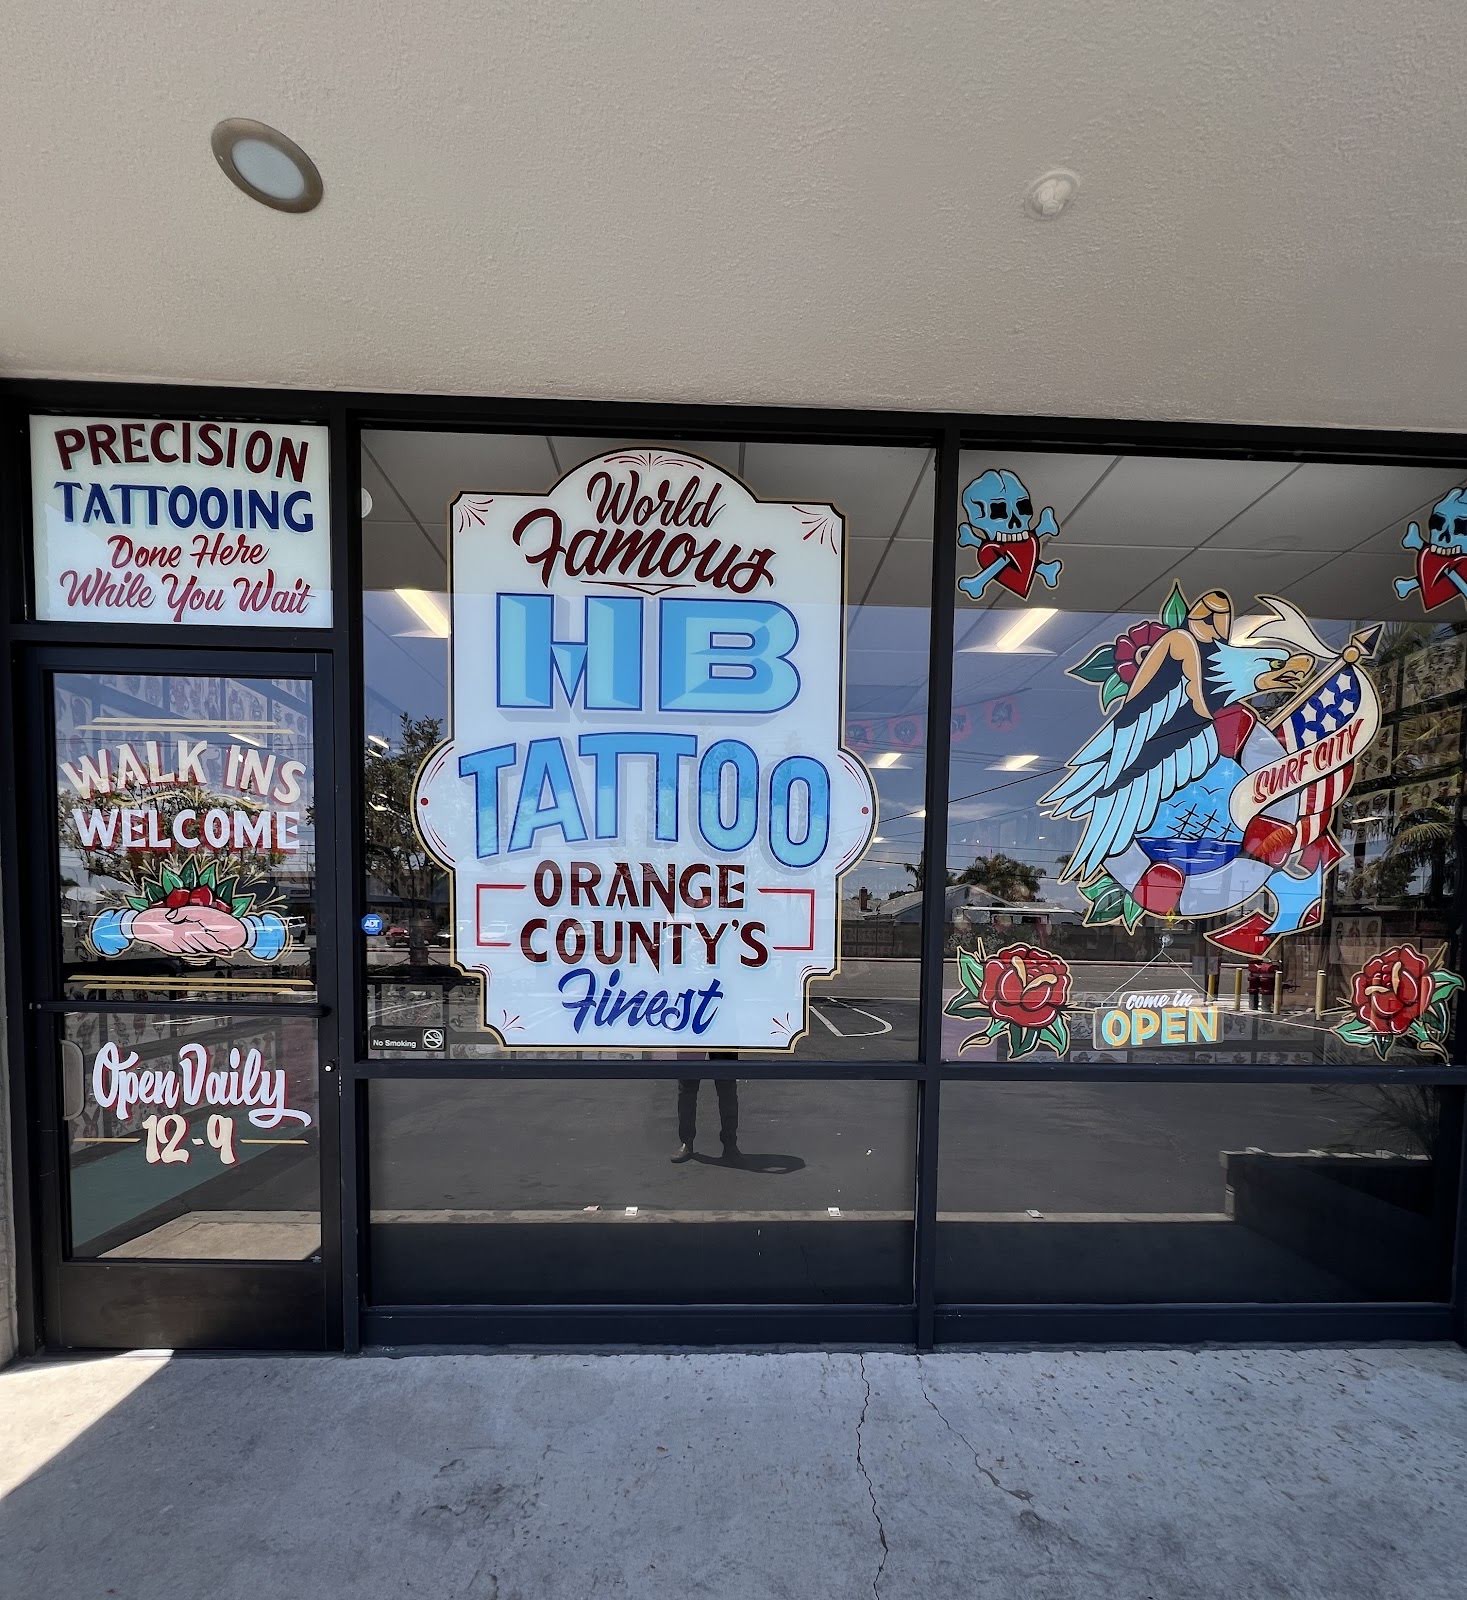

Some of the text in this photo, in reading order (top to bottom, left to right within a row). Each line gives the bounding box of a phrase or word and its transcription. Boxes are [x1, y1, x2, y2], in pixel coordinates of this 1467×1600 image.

[54, 422, 309, 483] PRECISION
[54, 481, 314, 533] TATTOOING
[586, 470, 726, 528] World
[107, 532, 270, 569] Done Here
[512, 507, 776, 594] Famous
[59, 568, 316, 622] While You Wait
[495, 592, 801, 714] HB
[59, 740, 306, 804] WALK INS
[1252, 718, 1365, 804] SURF CITY
[458, 731, 831, 869] TATTOO
[73, 808, 300, 850] WELCOME
[533, 859, 746, 915] ORANGE
[519, 918, 769, 973] COUNTY'S
[558, 968, 724, 1035] Finest
[1101, 1006, 1218, 1047] OPEN
[1125, 991, 1193, 1010] come in
[373, 1039, 416, 1049] No Smoking
[92, 1041, 312, 1128] Open Daily
[142, 1114, 236, 1164] 12-9
